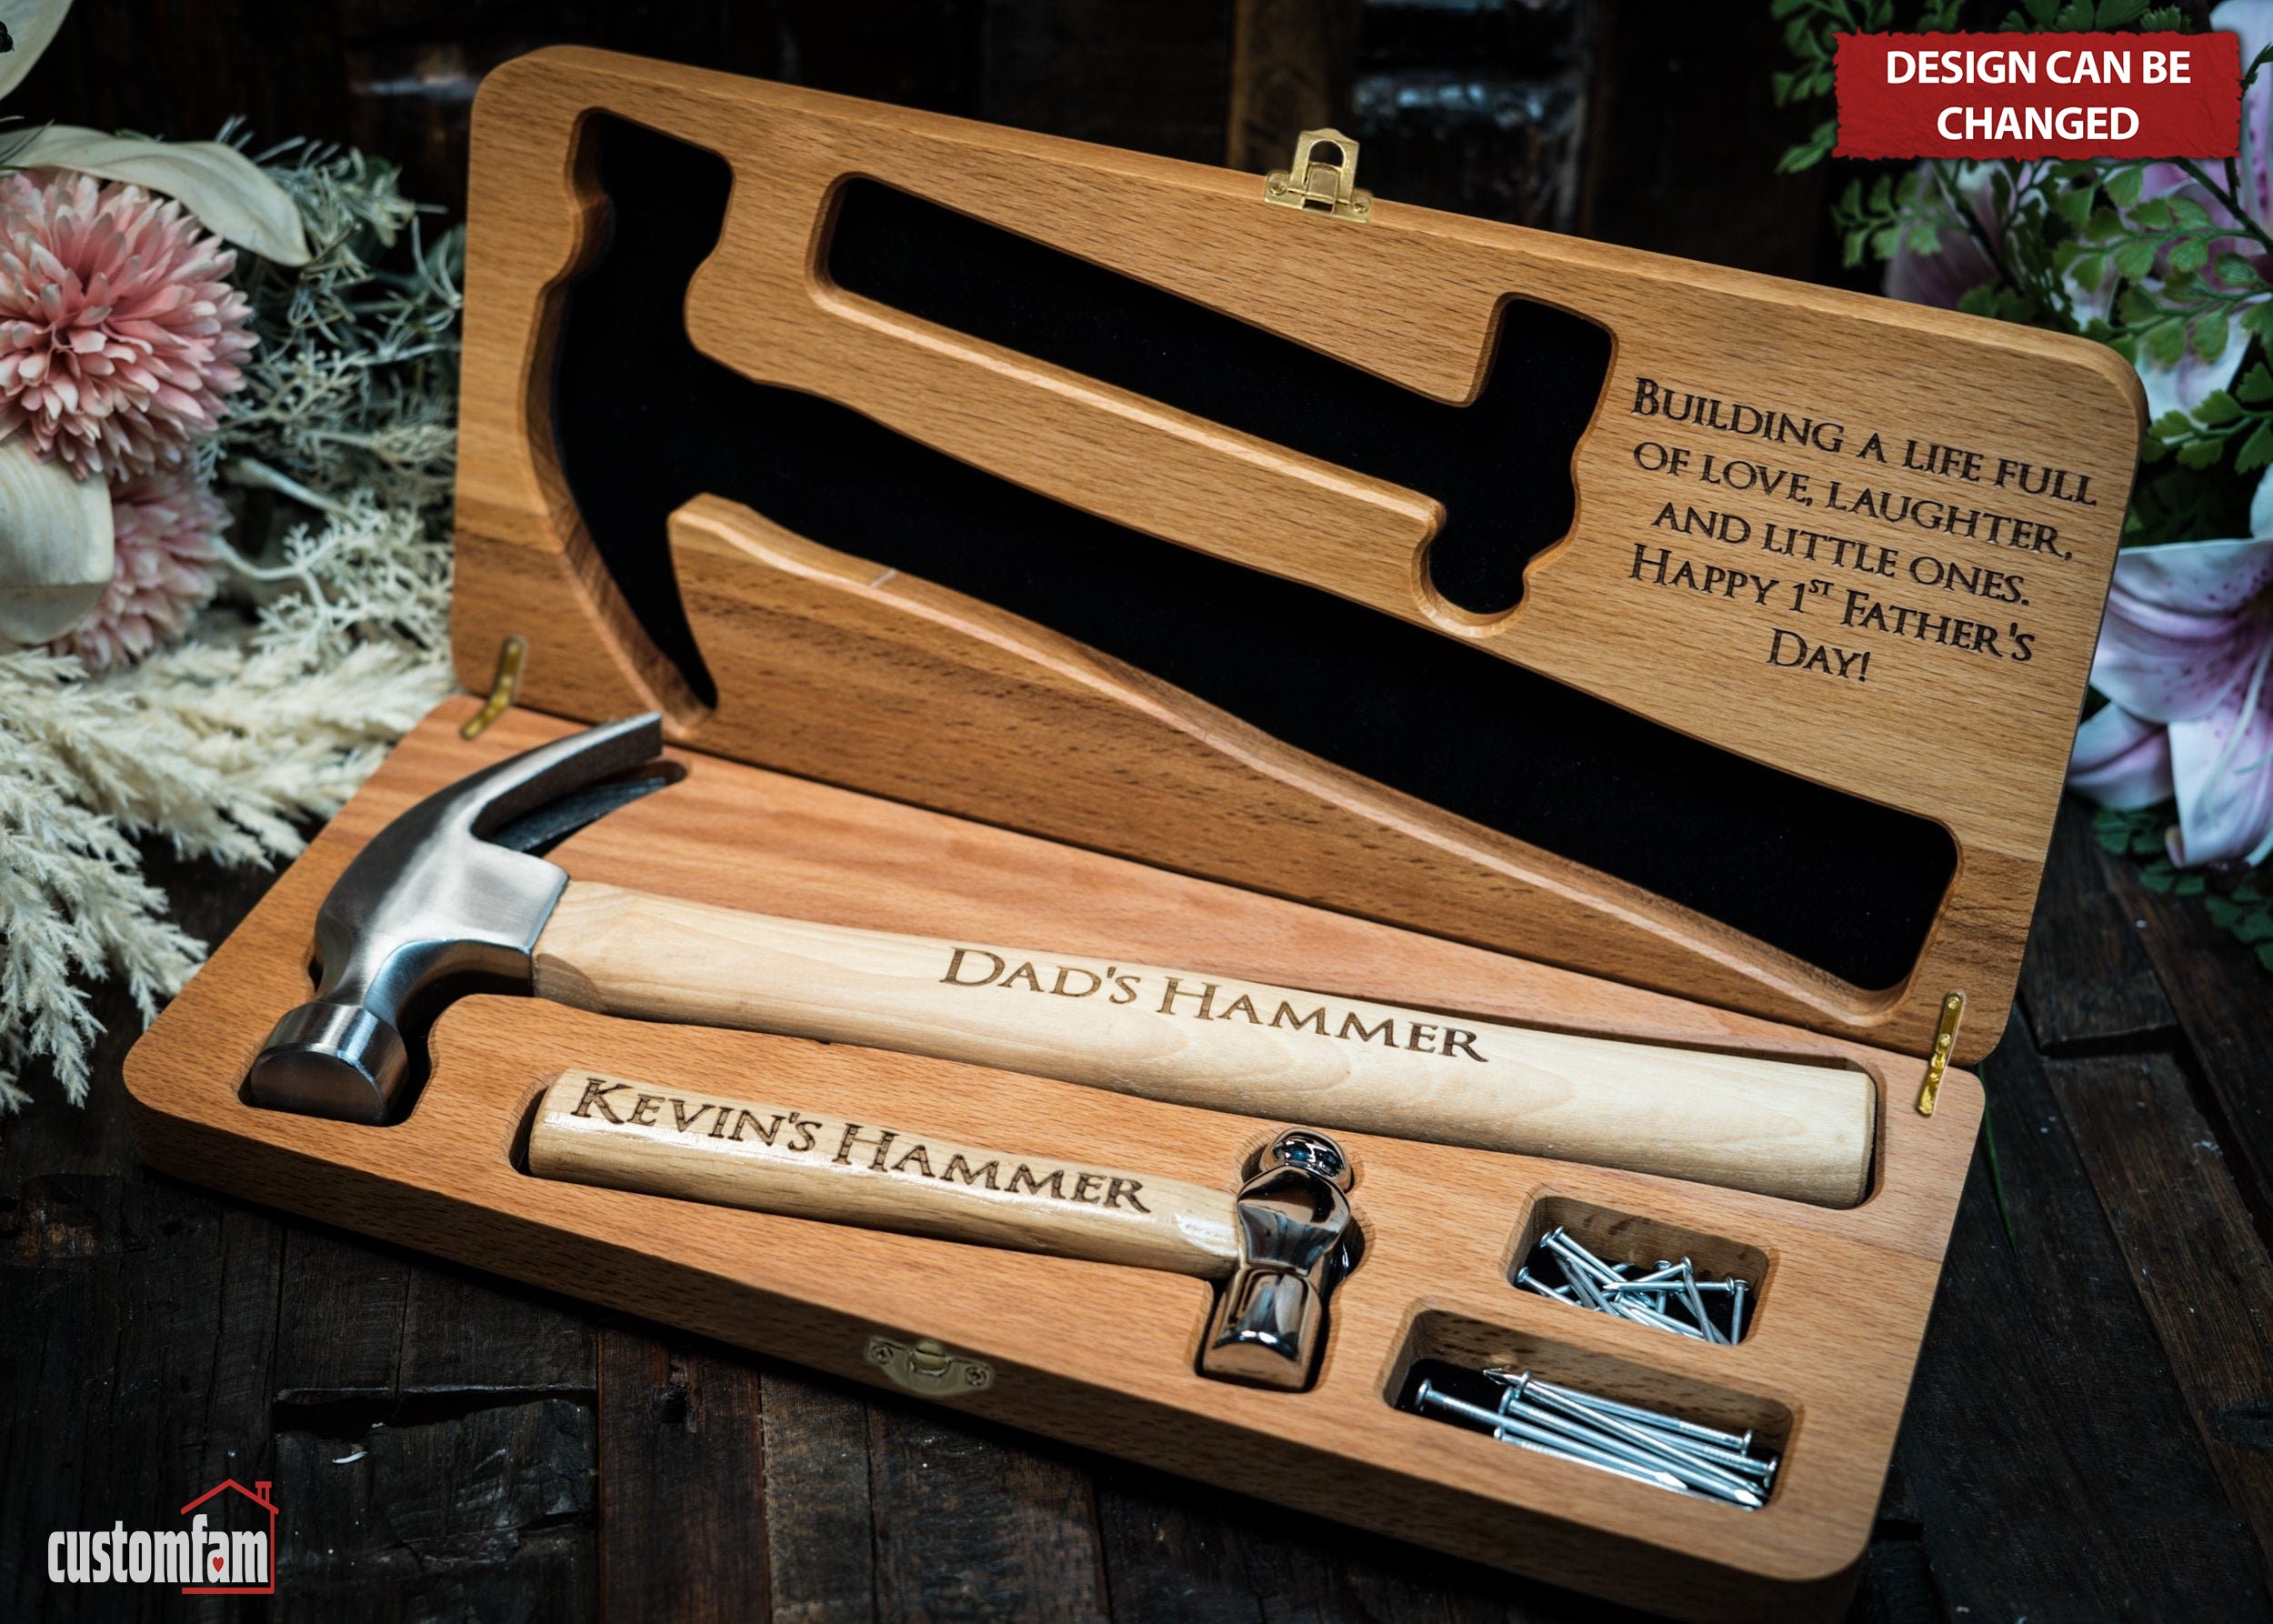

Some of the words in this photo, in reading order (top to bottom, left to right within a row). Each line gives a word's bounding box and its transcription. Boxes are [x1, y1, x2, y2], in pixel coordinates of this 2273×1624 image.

[1631, 377, 1844, 454] BUILDING
[1857, 433, 1887, 464] A
[1901, 440, 1984, 482] LIFE
[1994, 458, 2097, 507] FULL
[1633, 442, 1691, 476] OF
[1700, 455, 1814, 506] LOVE,
[1827, 481, 2073, 562] LAUGHTER,
[1650, 502, 1751, 544] AND
[1762, 523, 1898, 578] LITTLE
[1908, 556, 2030, 606] ONES.
[1628, 544, 1779, 606] HAPPY
[1839, 588, 2036, 662] FATHER'S
[1767, 628, 1871, 683] DAY!
[939, 947, 1141, 1004] DAD'S
[1157, 977, 1489, 1062] HAMMER
[570, 1077, 822, 1152] KEVIN'S
[832, 1122, 1152, 1215] HAMMER
